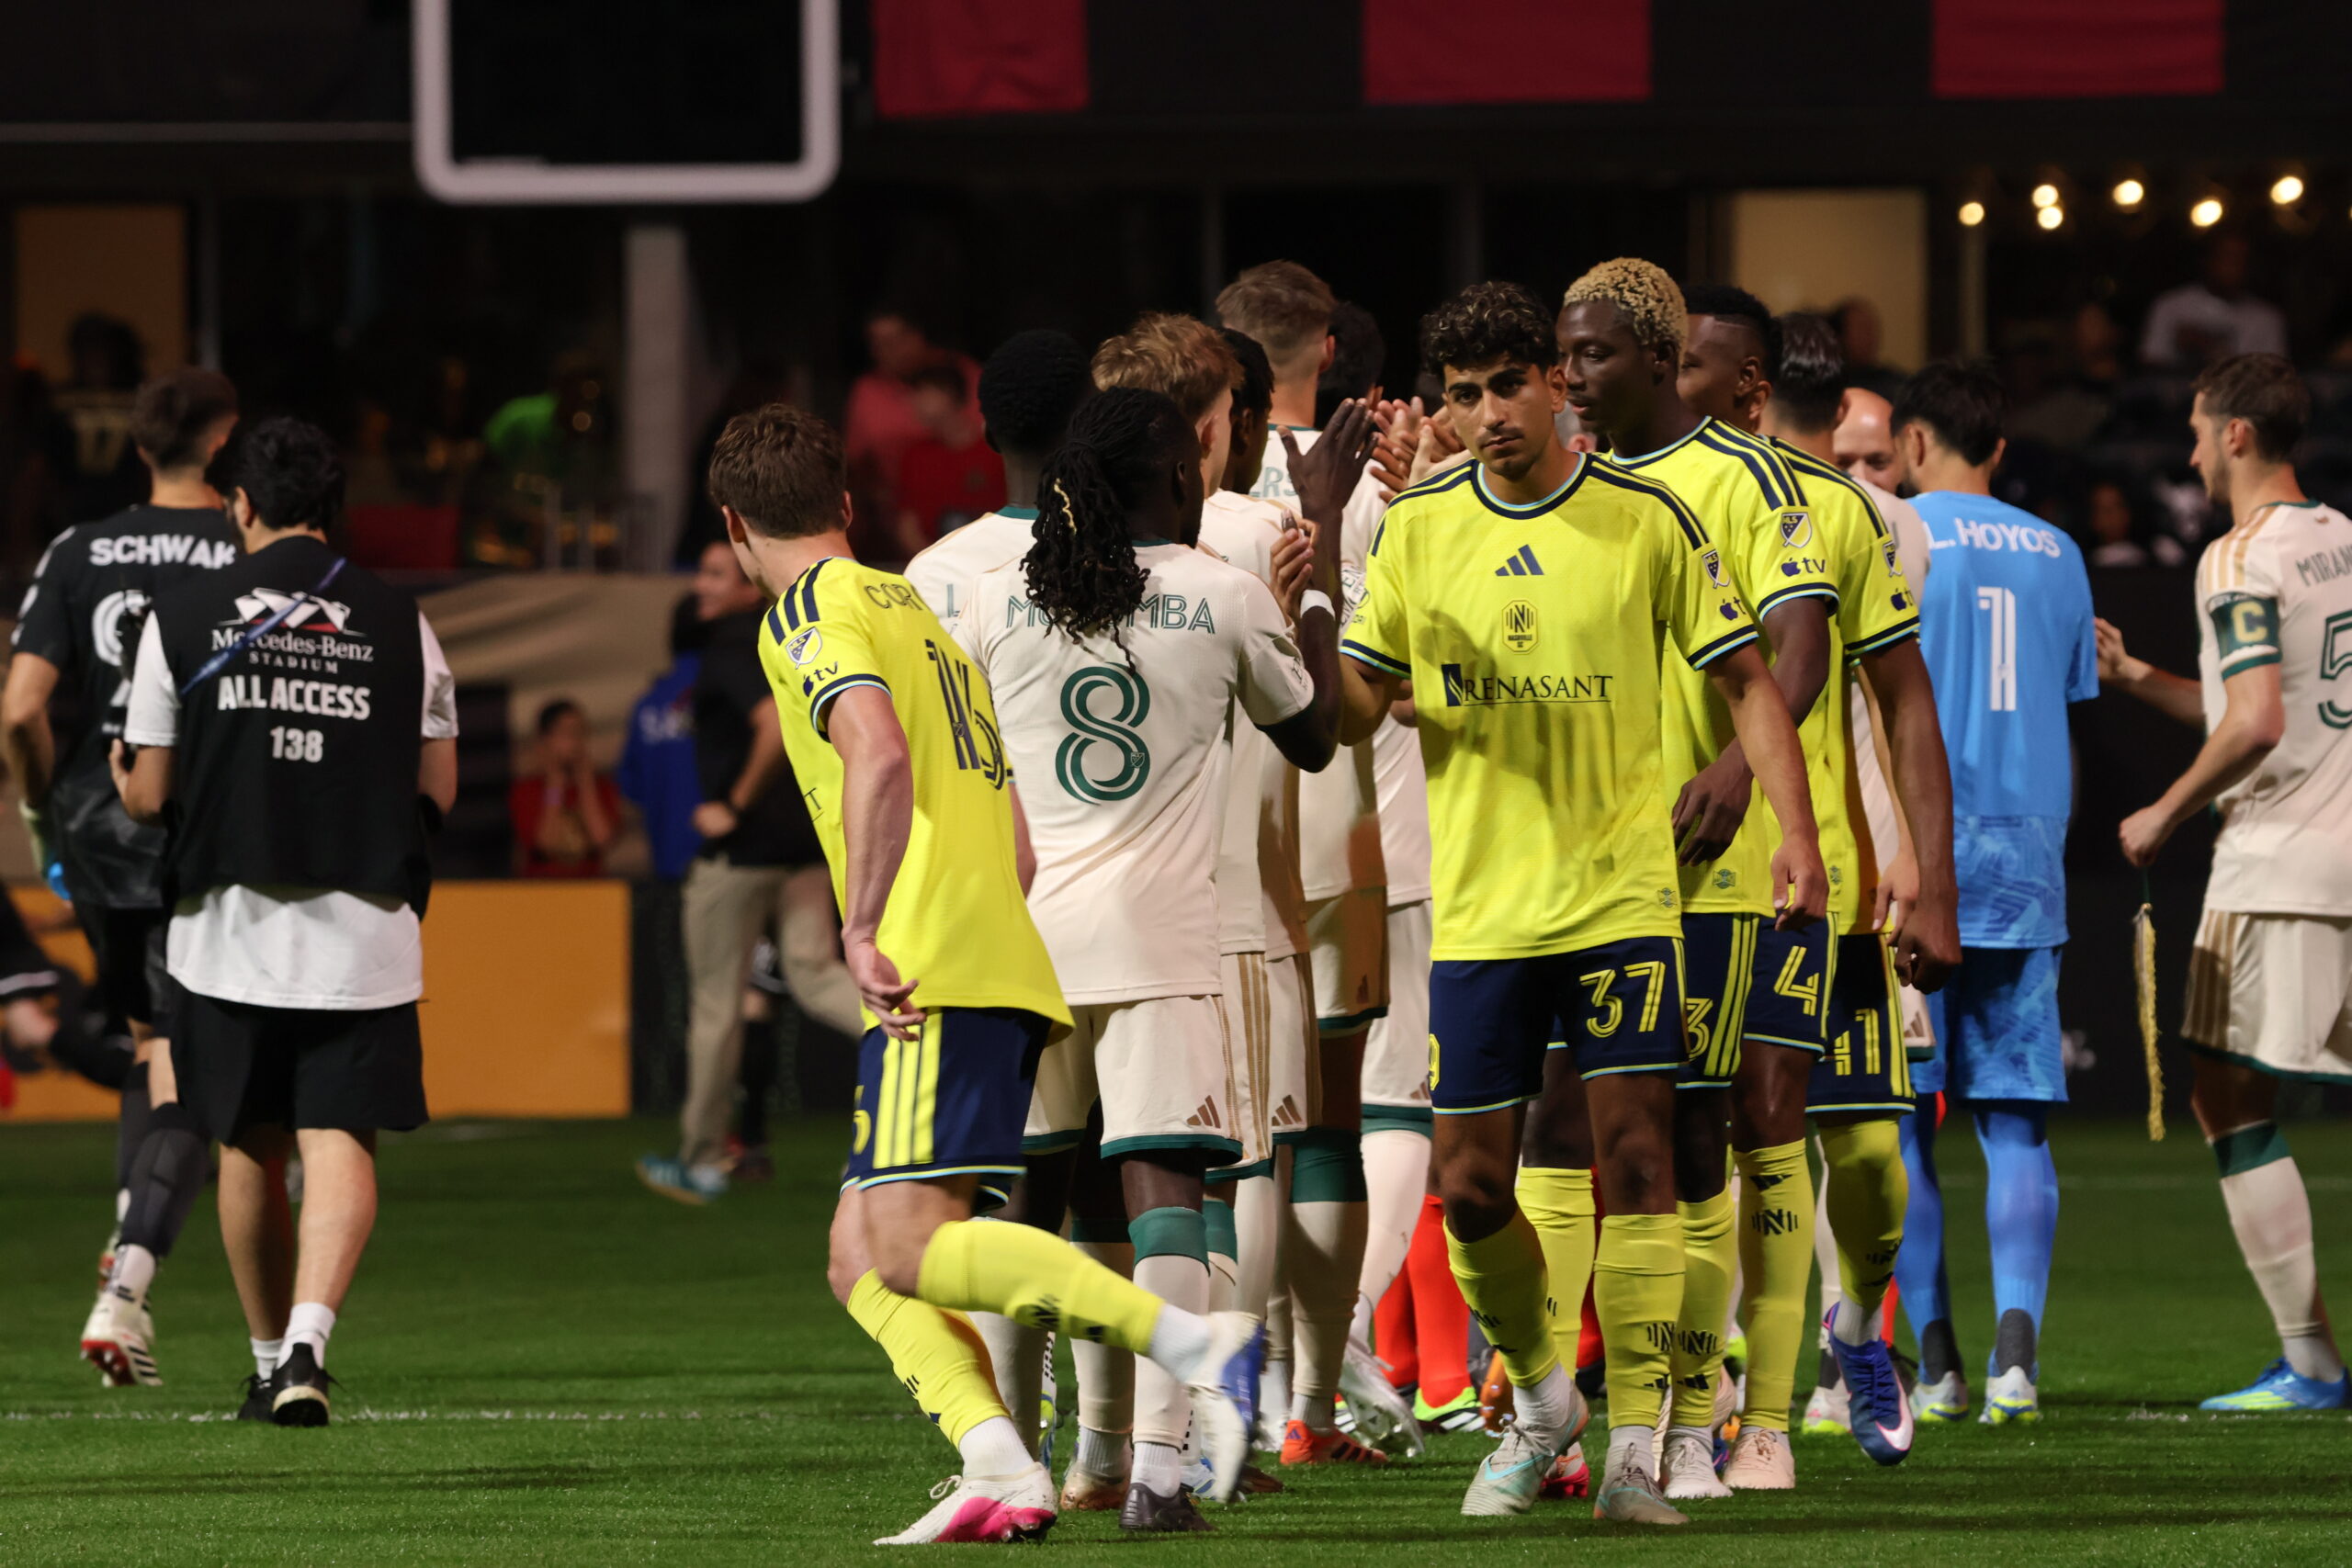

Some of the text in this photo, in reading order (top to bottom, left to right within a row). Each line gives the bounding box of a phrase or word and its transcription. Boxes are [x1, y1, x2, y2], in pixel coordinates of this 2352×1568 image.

[1954, 517, 2061, 558] HOYOS
[1802, 558, 1826, 573] tv
[1006, 593, 1216, 634] MMBA
[2232, 601, 2267, 643] C
[211, 627, 374, 662] Mecedes-Benz
[249, 651, 339, 674] STADIUM
[1977, 586, 2017, 711] 1
[813, 661, 838, 682] tv
[1464, 675, 1613, 701] RENASANT
[218, 674, 371, 721] ALL ACCESS
[270, 726, 323, 762] 138
[1055, 661, 1150, 806] 8
[1579, 961, 1667, 1038] 37
[1773, 945, 1819, 1016] 4
